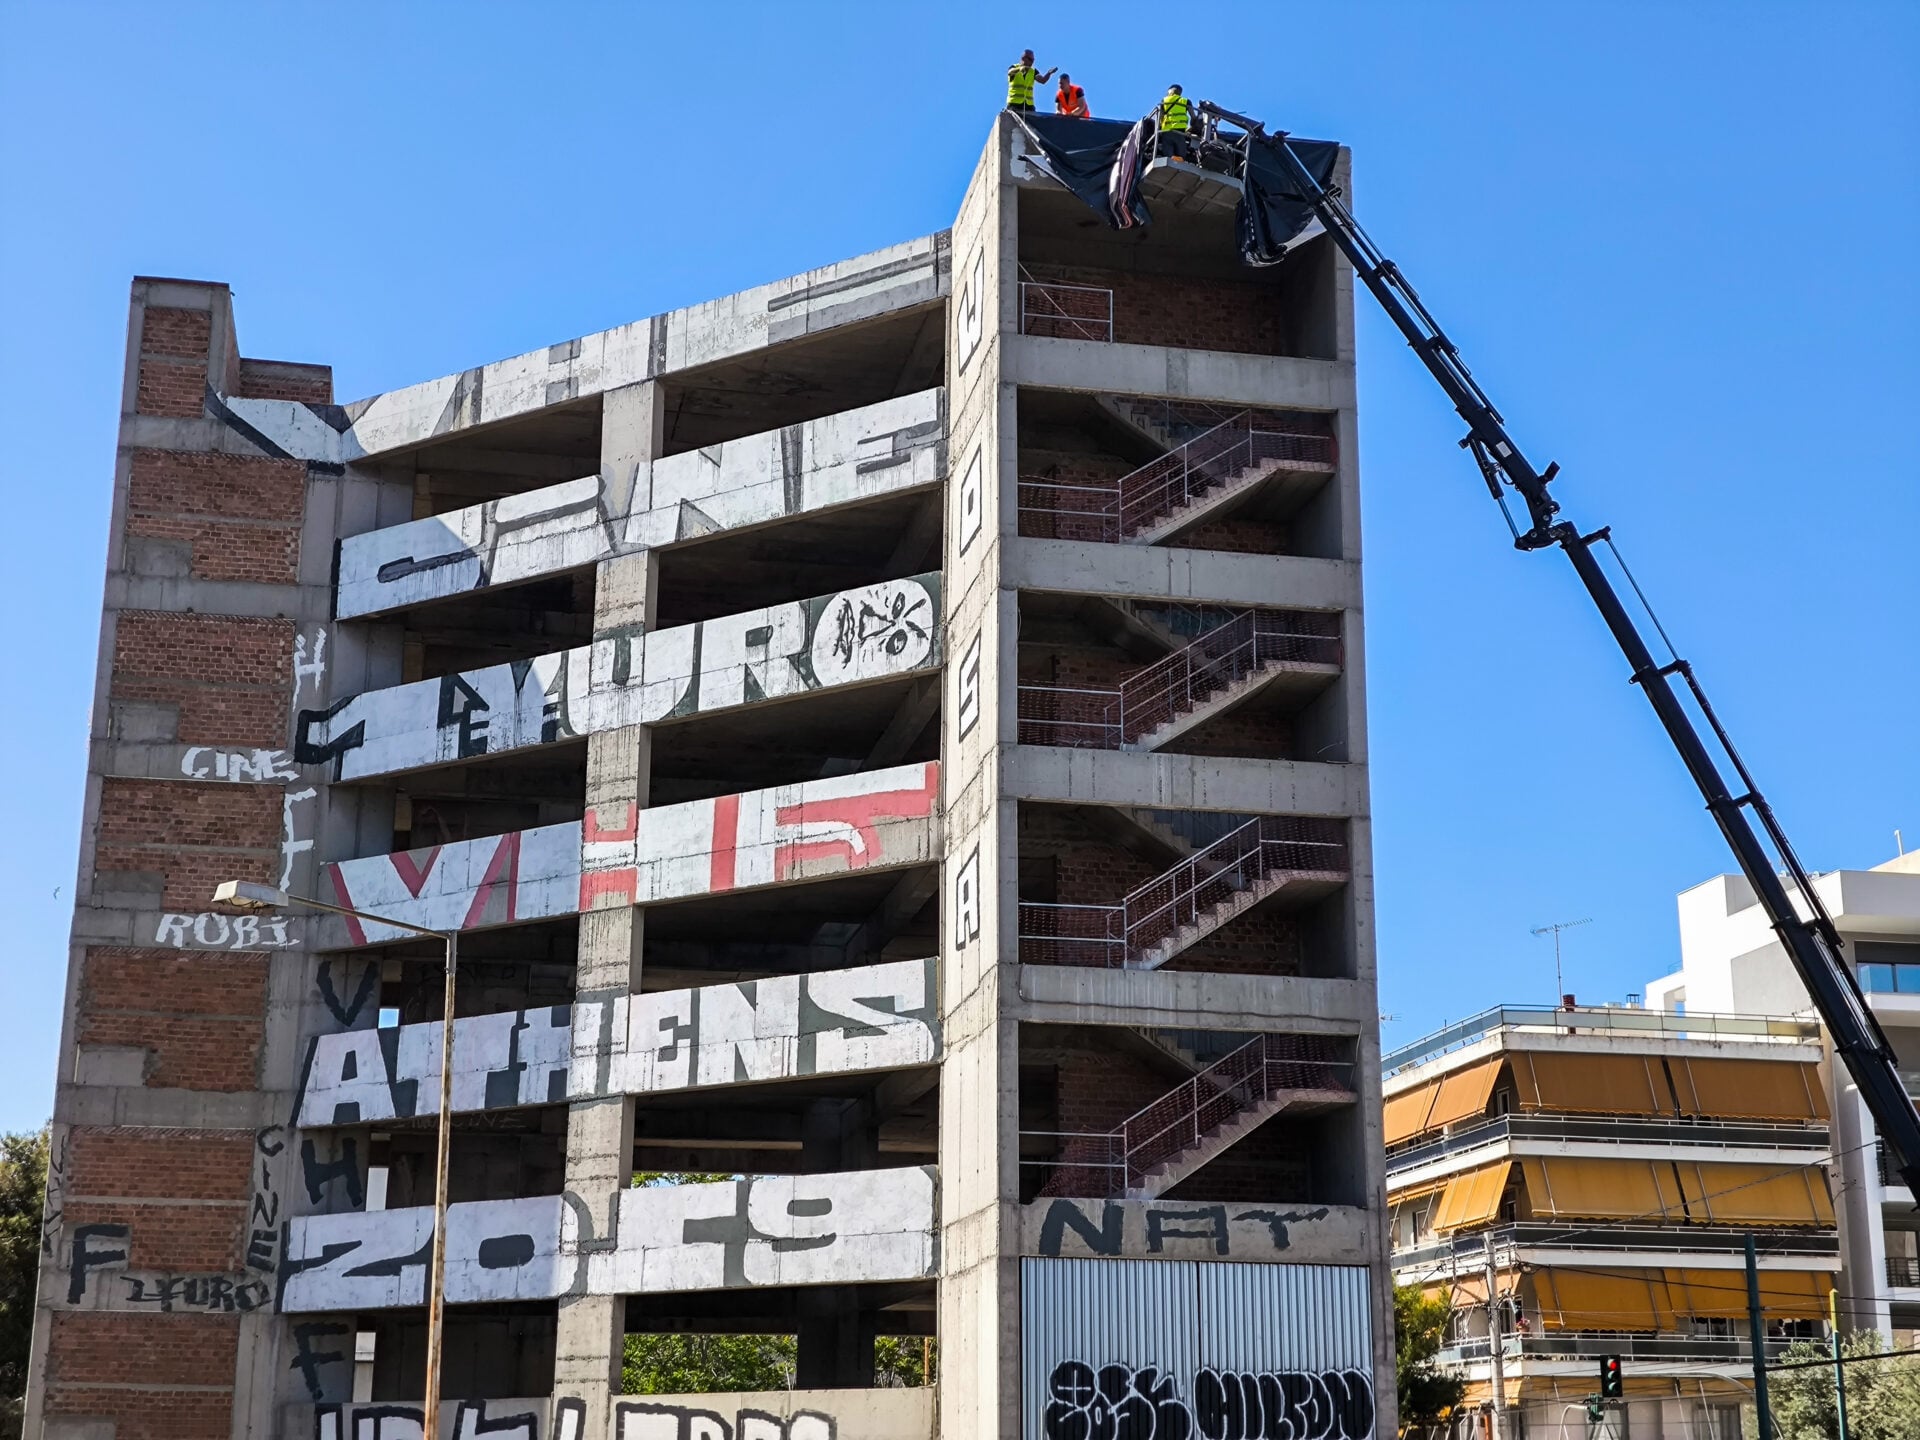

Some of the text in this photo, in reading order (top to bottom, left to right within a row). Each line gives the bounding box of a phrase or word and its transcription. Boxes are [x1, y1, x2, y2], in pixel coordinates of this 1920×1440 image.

[181, 746, 300, 783] CINE
[290, 956, 938, 1129] ATHENS
[246, 1124, 286, 1274] CINE
